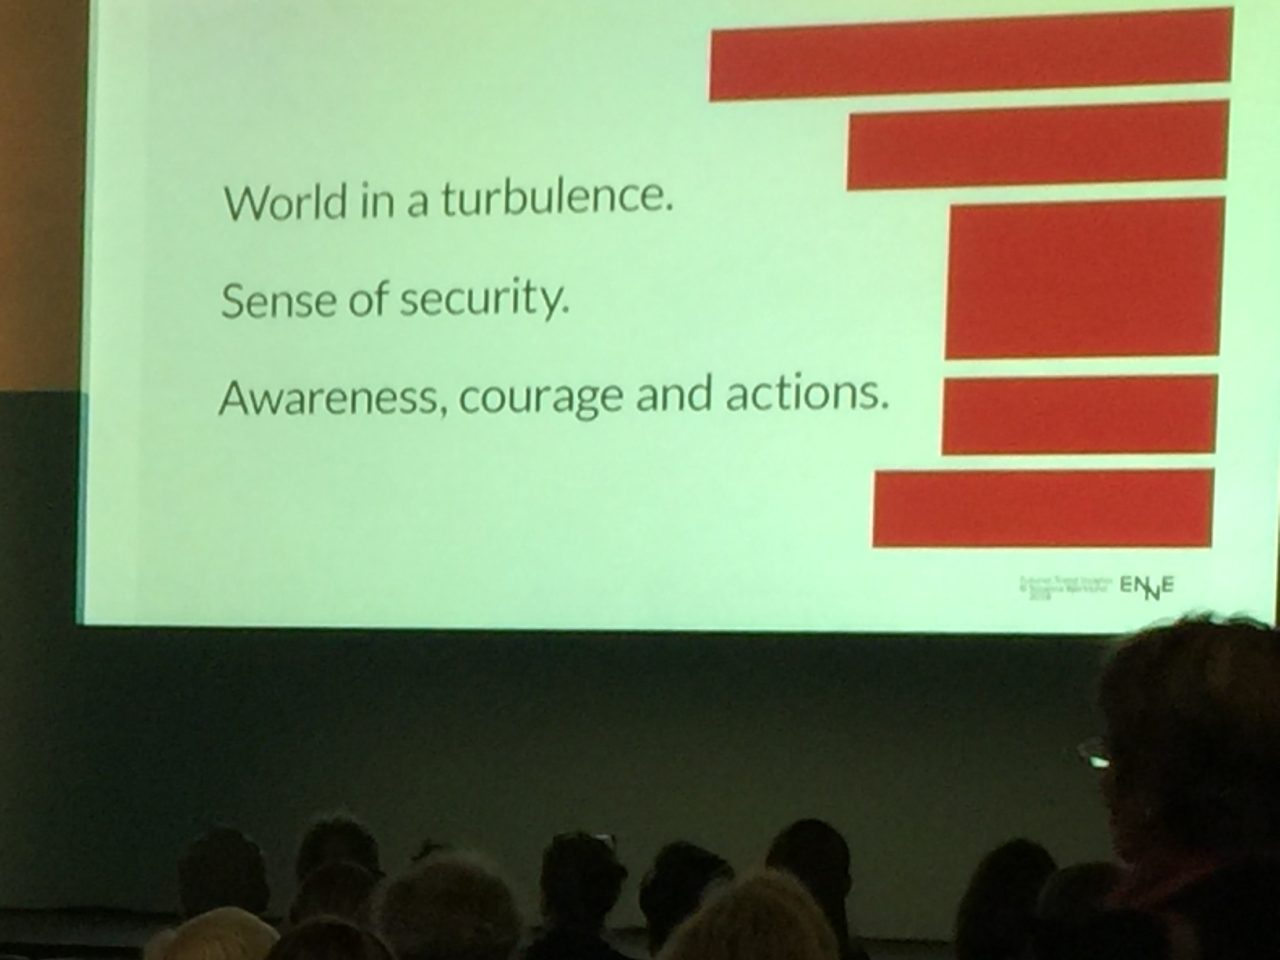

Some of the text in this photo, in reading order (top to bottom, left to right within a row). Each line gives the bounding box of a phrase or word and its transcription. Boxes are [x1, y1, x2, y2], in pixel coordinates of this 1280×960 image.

[223, 176, 675, 221] World in a turbulence.
[220, 276, 571, 322] Sense of security.
[218, 370, 891, 423] Awareness, courage and actions.
